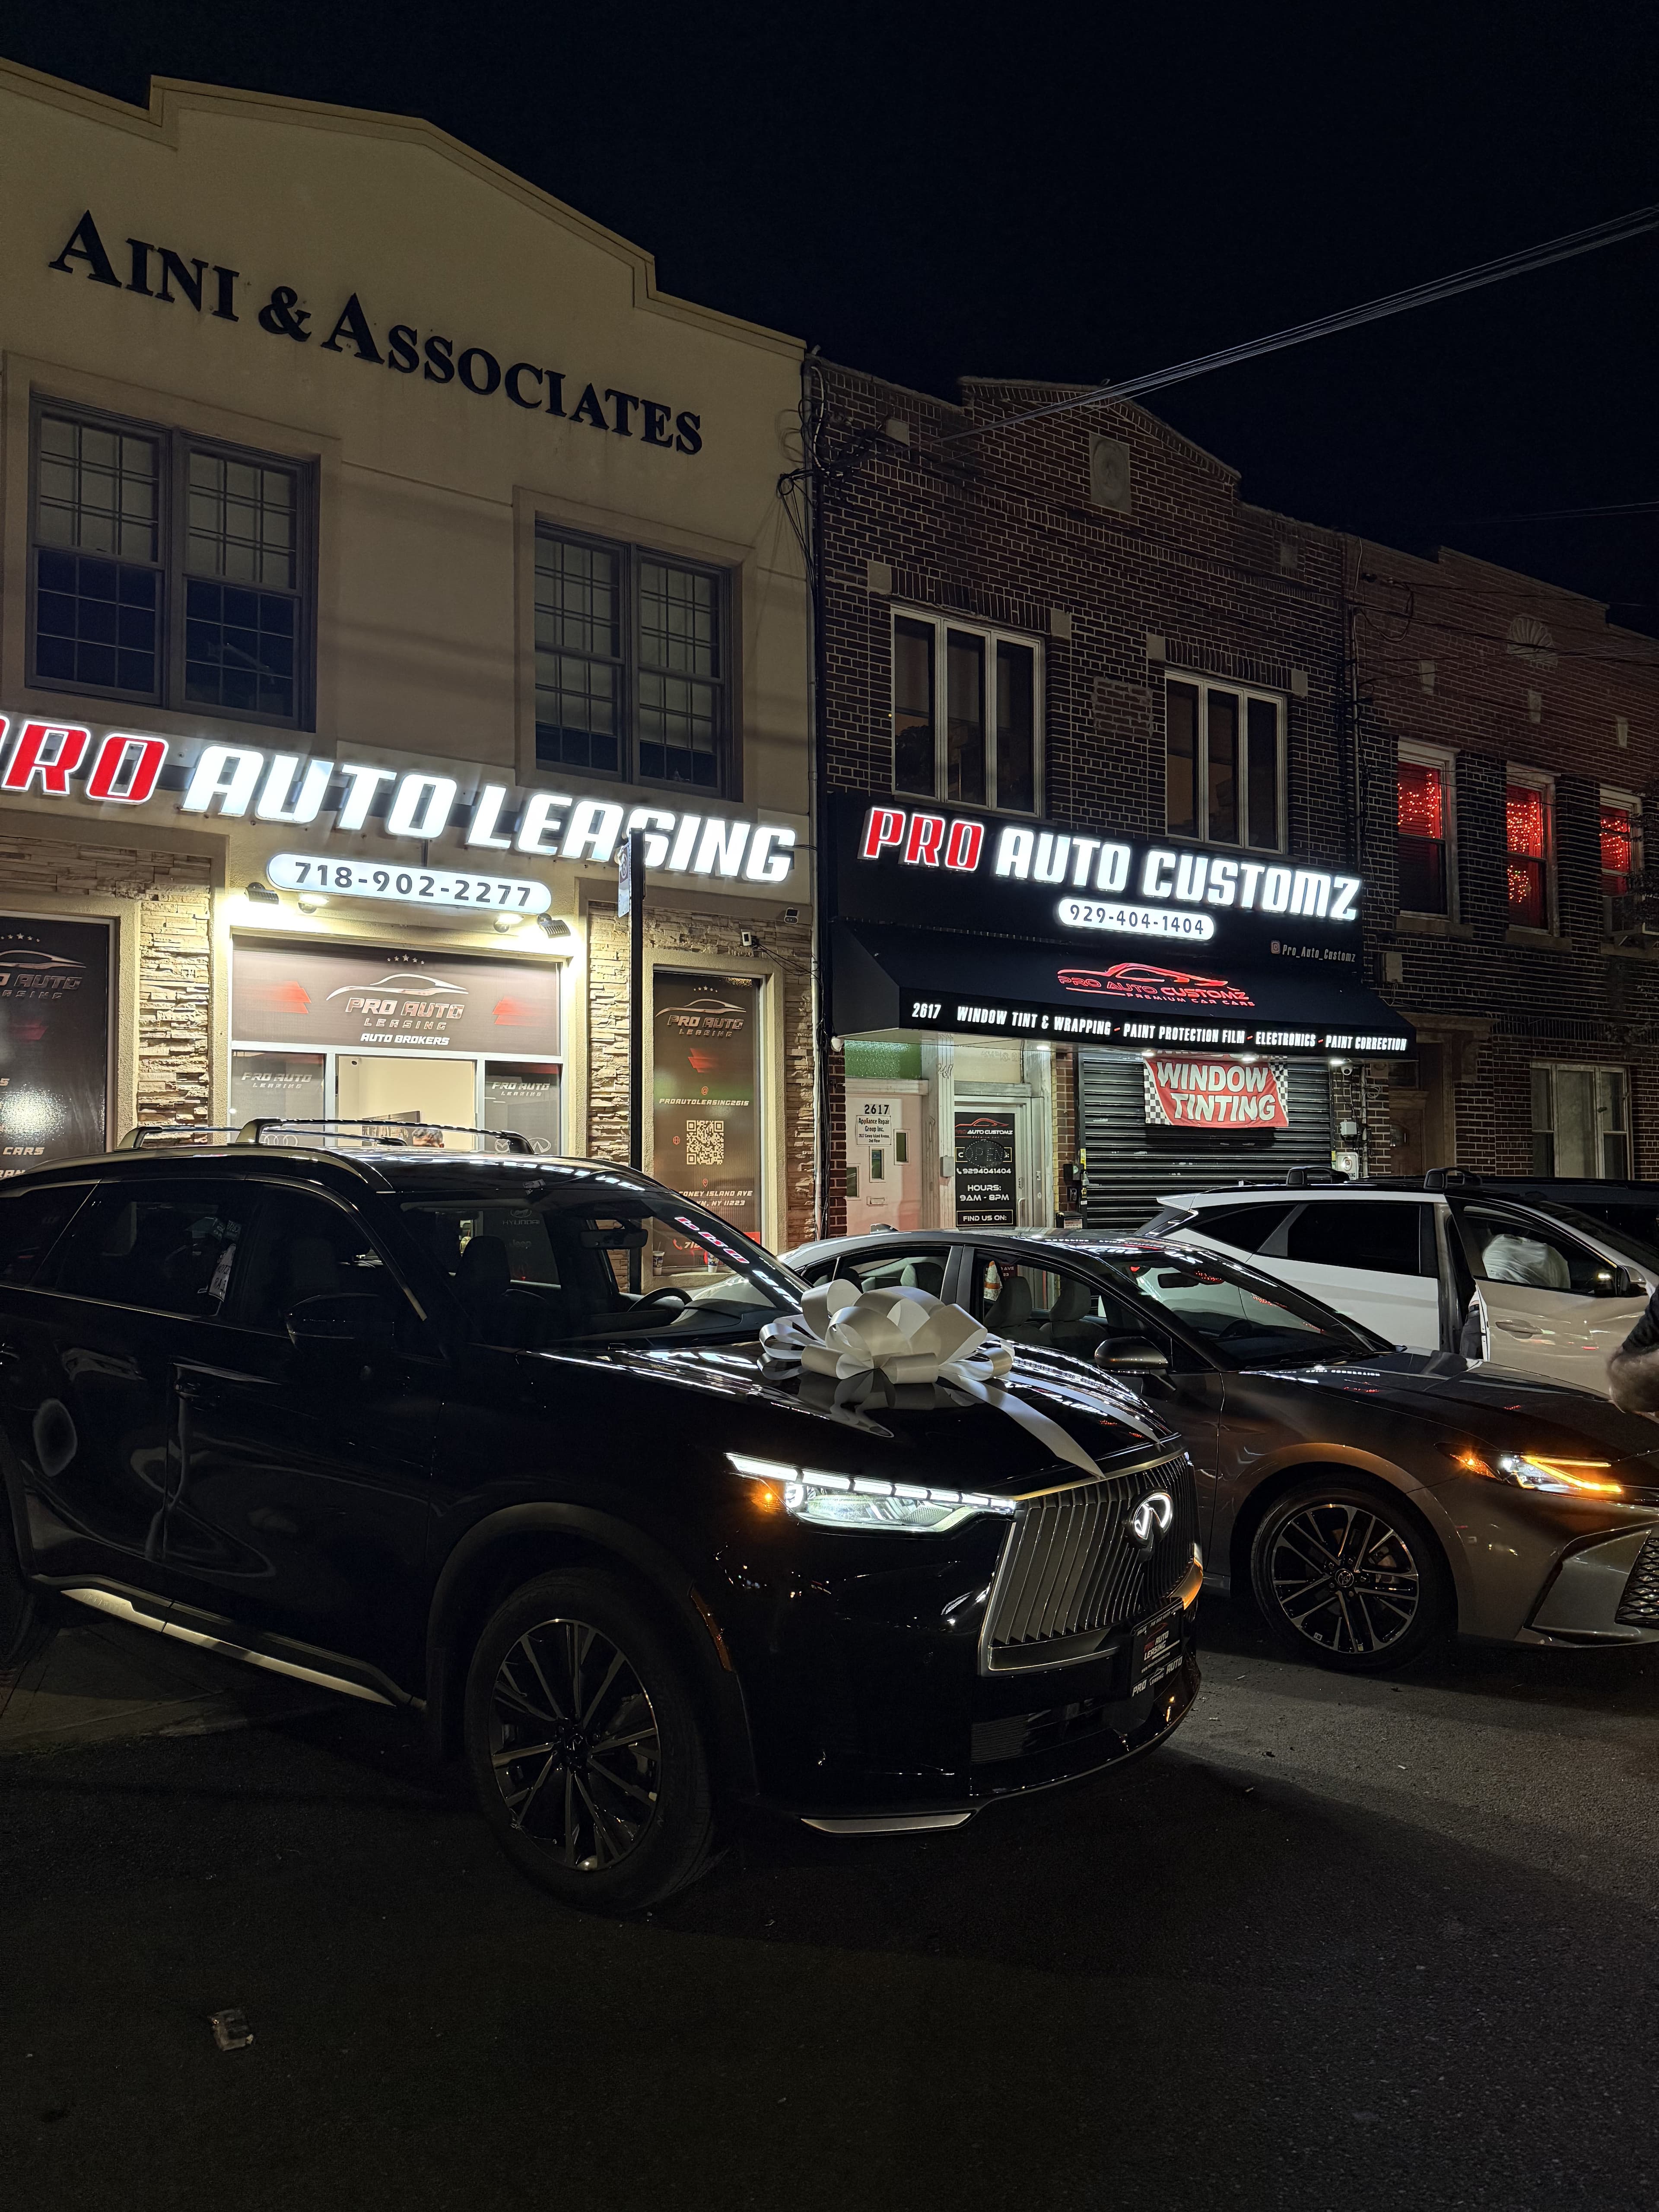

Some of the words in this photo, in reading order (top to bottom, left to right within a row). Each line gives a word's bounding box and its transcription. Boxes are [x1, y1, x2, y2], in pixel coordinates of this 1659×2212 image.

[48, 210, 240, 322] AINI
[259, 286, 312, 342] &
[320, 292, 703, 454] ASSOCIATES
[0, 715, 169, 805] RO
[180, 745, 457, 838] AUTO
[466, 784, 797, 883] LEASING
[862, 807, 985, 872] PRO
[995, 826, 1131, 892] AUTO
[1143, 849, 1362, 921] CUSTOMZ
[296, 861, 531, 906] 718-902-2277
[1070, 905, 1203, 934] 929-404-1404
[1282, 944, 1356, 962] Pro_Auto_Customz
[14, 974, 83, 990] AUTO
[1058, 976, 1102, 988] PRO
[1106, 982, 1158, 994] AUTO
[1160, 987, 1249, 1000] CUSTOMZ
[1125, 993, 1186, 1002] PREMIUM
[346, 998, 398, 1015] PRO
[401, 1001, 465, 1019] AUTO
[364, 1018, 447, 1030] LEASING
[667, 1015, 700, 1027] PRO
[702, 1017, 744, 1030] AUTO
[912, 1003, 941, 1019] 2617
[957, 1006, 1007, 1025] WINDOW
[1012, 1011, 1038, 1029] TINT
[1042, 1016, 1049, 1029] &
[1054, 1017, 1111, 1036] WRAPPING
[1123, 1023, 1156, 1039] PAINT
[1159, 1026, 1219, 1043] PROTECTION
[1222, 1030, 1245, 1044] FILM
[1255, 1032, 1316, 1047] ELECTRONICS
[1325, 1035, 1353, 1049] PAINT
[1355, 1037, 1407, 1051] CORRECTION
[360, 1033, 393, 1043] AUTO
[394, 1035, 450, 1046] BROKERS
[679, 1029, 733, 1037] LEASING
[242, 1072, 272, 1081] PRO
[273, 1073, 312, 1082] AUTO
[492, 1082, 517, 1090] PRO
[1157, 1062, 1268, 1093] WINDOW
[864, 1104, 889, 1114] 2617
[1170, 1093, 1275, 1121] TINTING
[3, 1147, 45, 1155] CARS
[1155, 1630, 1169, 1645] AUTO
[1144, 1640, 1166, 1661] LEASING
[1132, 1679, 1147, 1697] PRO
[1166, 1656, 1183, 1675] AUTO
